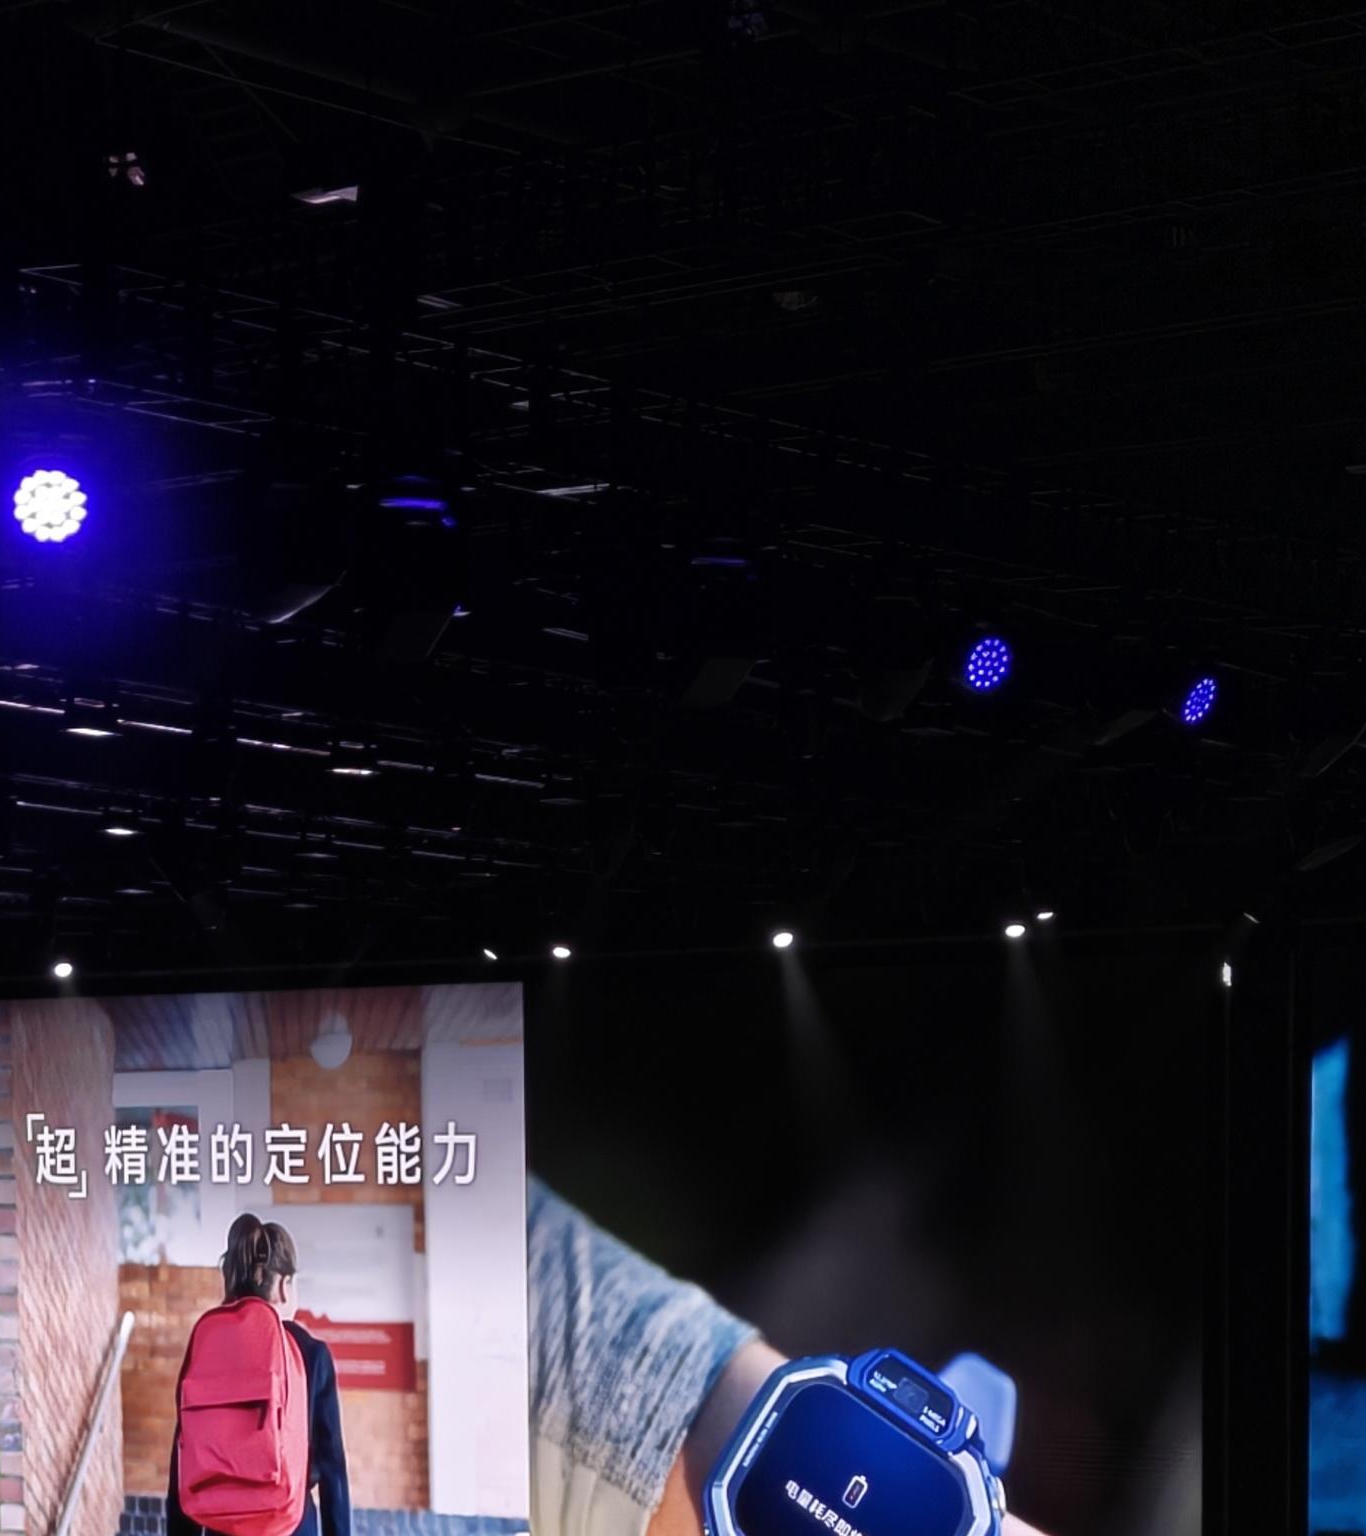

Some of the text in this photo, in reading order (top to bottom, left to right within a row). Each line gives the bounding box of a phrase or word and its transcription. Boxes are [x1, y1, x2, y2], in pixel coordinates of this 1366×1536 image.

[103, 1121, 478, 1186] 精准的定位能力
